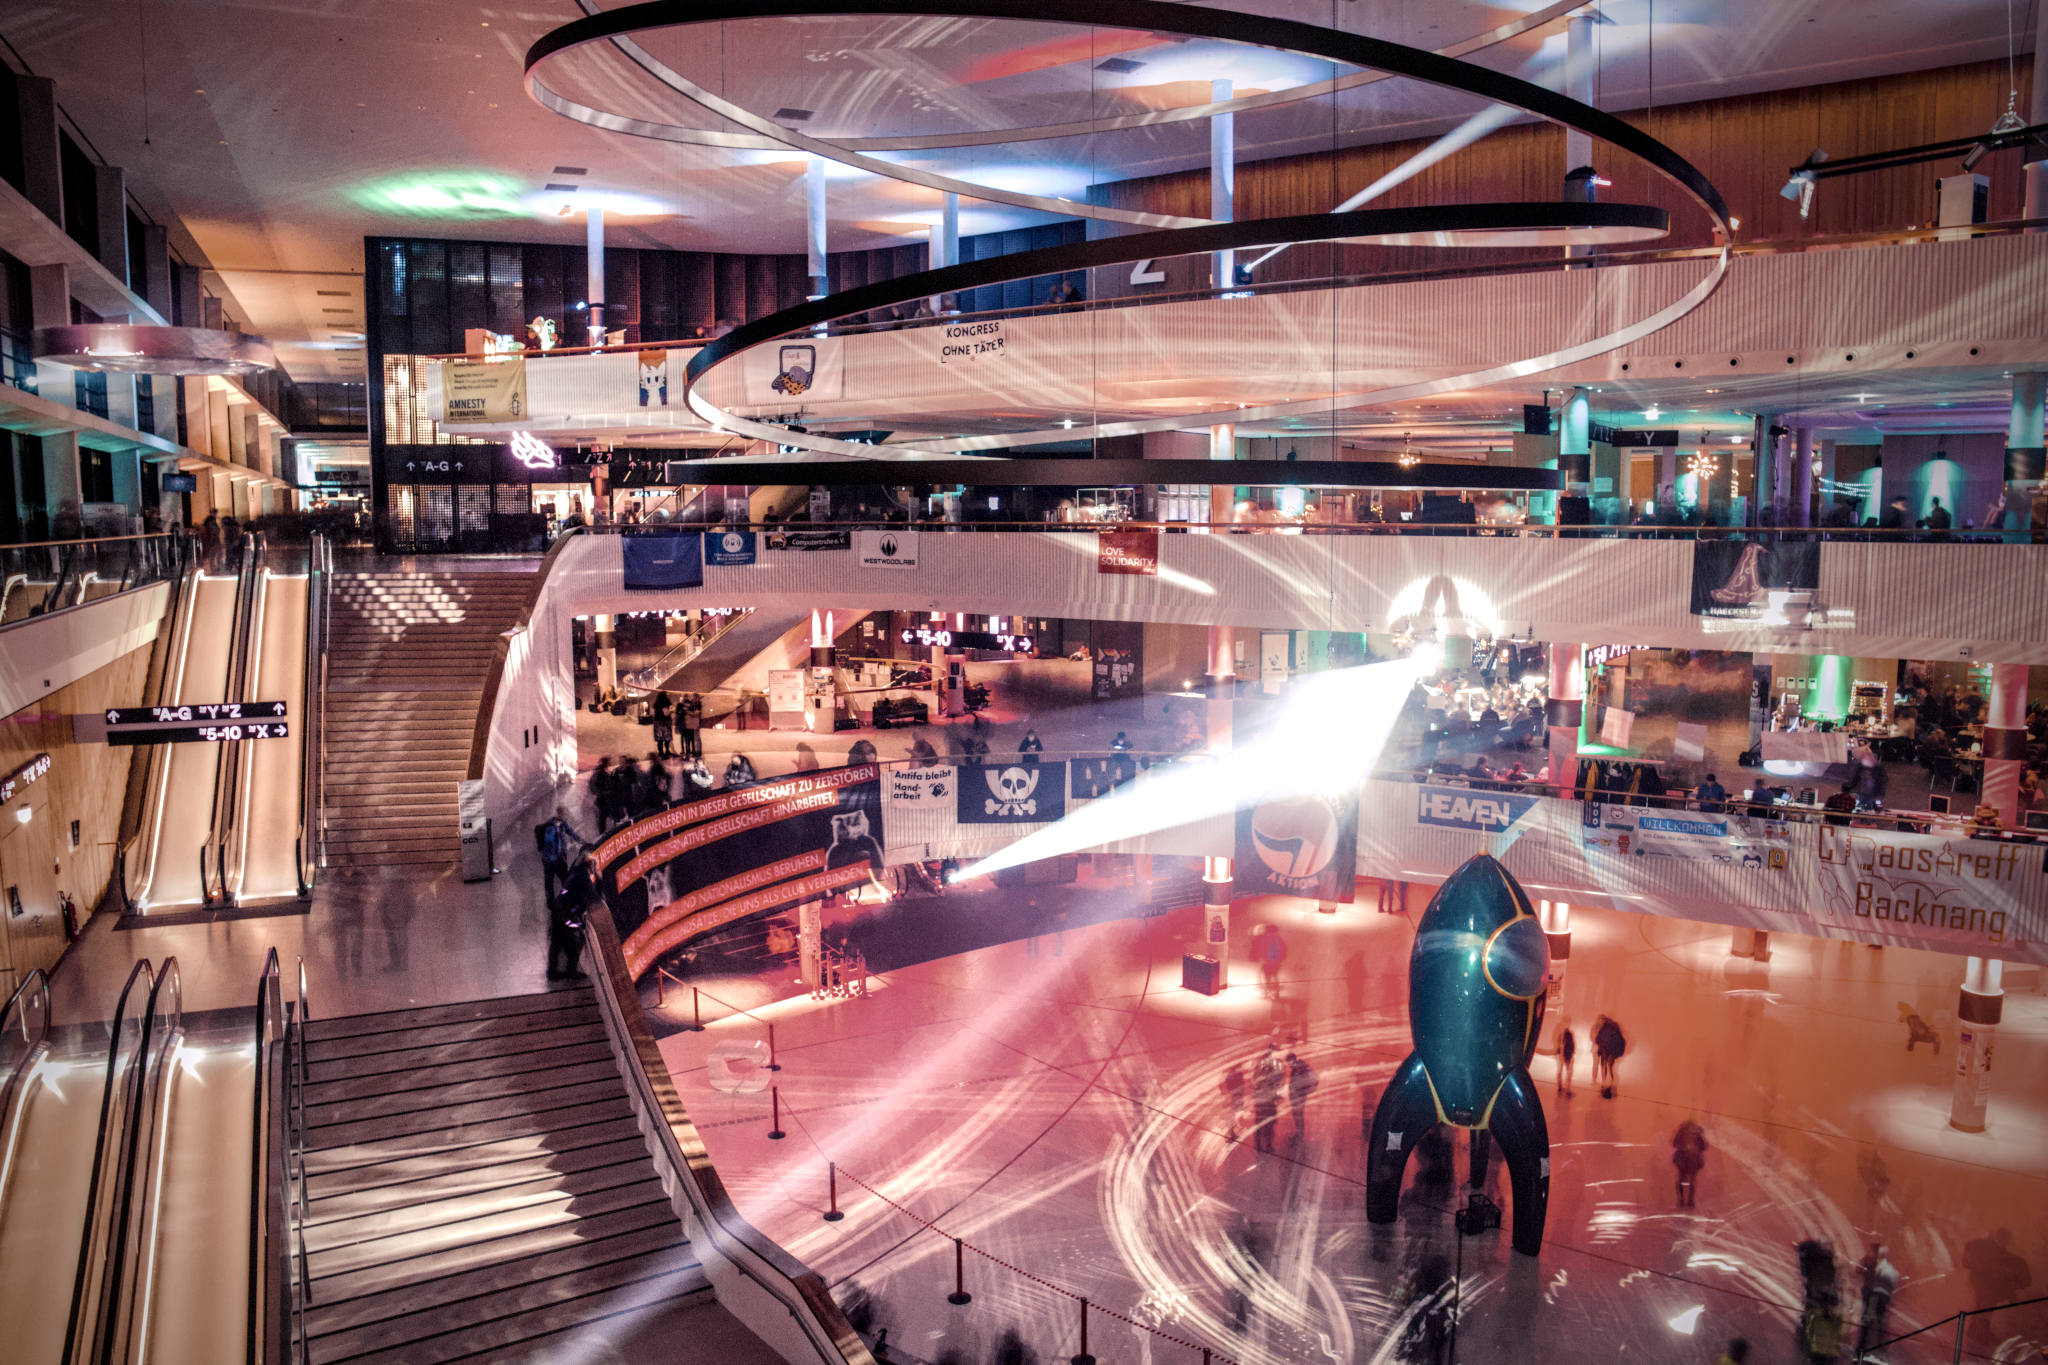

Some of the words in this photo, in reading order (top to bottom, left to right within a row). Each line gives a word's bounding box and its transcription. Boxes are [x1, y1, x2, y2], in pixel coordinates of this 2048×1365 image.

[946, 322, 999, 338] KONGRESS
[942, 345, 970, 356] OHNE
[974, 338, 1004, 353] TÄTER
[449, 399, 486, 409] AMNESTY
[1101, 547, 1124, 556] LOVE
[921, 630, 952, 647] 5-10
[159, 706, 192, 721] A-G
[206, 726, 242, 741] 5-10
[895, 770, 922, 780] Antifa
[926, 769, 951, 780] bleibt
[894, 783, 921, 791] Hand-
[893, 792, 921, 800] arbeit
[627, 808, 687, 844] ZUSAMMENLEBEN
[687, 806, 698, 820] IN
[700, 799, 728, 817] DIESER
[729, 782, 797, 807] GESELLSCHAFT
[798, 780, 813, 795] ZU
[814, 766, 874, 790] ZERSTÖREN
[1420, 792, 1510, 827] HEAVEN
[706, 808, 770, 839] GESELLSCHAFT
[773, 792, 836, 818] HINARBEITET,
[1643, 818, 1722, 836] WILLKOMMEN
[699, 867, 773, 903] NATIONALISMUS
[774, 854, 822, 877] BERUHEN.
[739, 898, 760, 914] UNS
[762, 891, 779, 905] ALS
[781, 883, 806, 899] CLUB
[1855, 882, 2006, 942] Backnang
